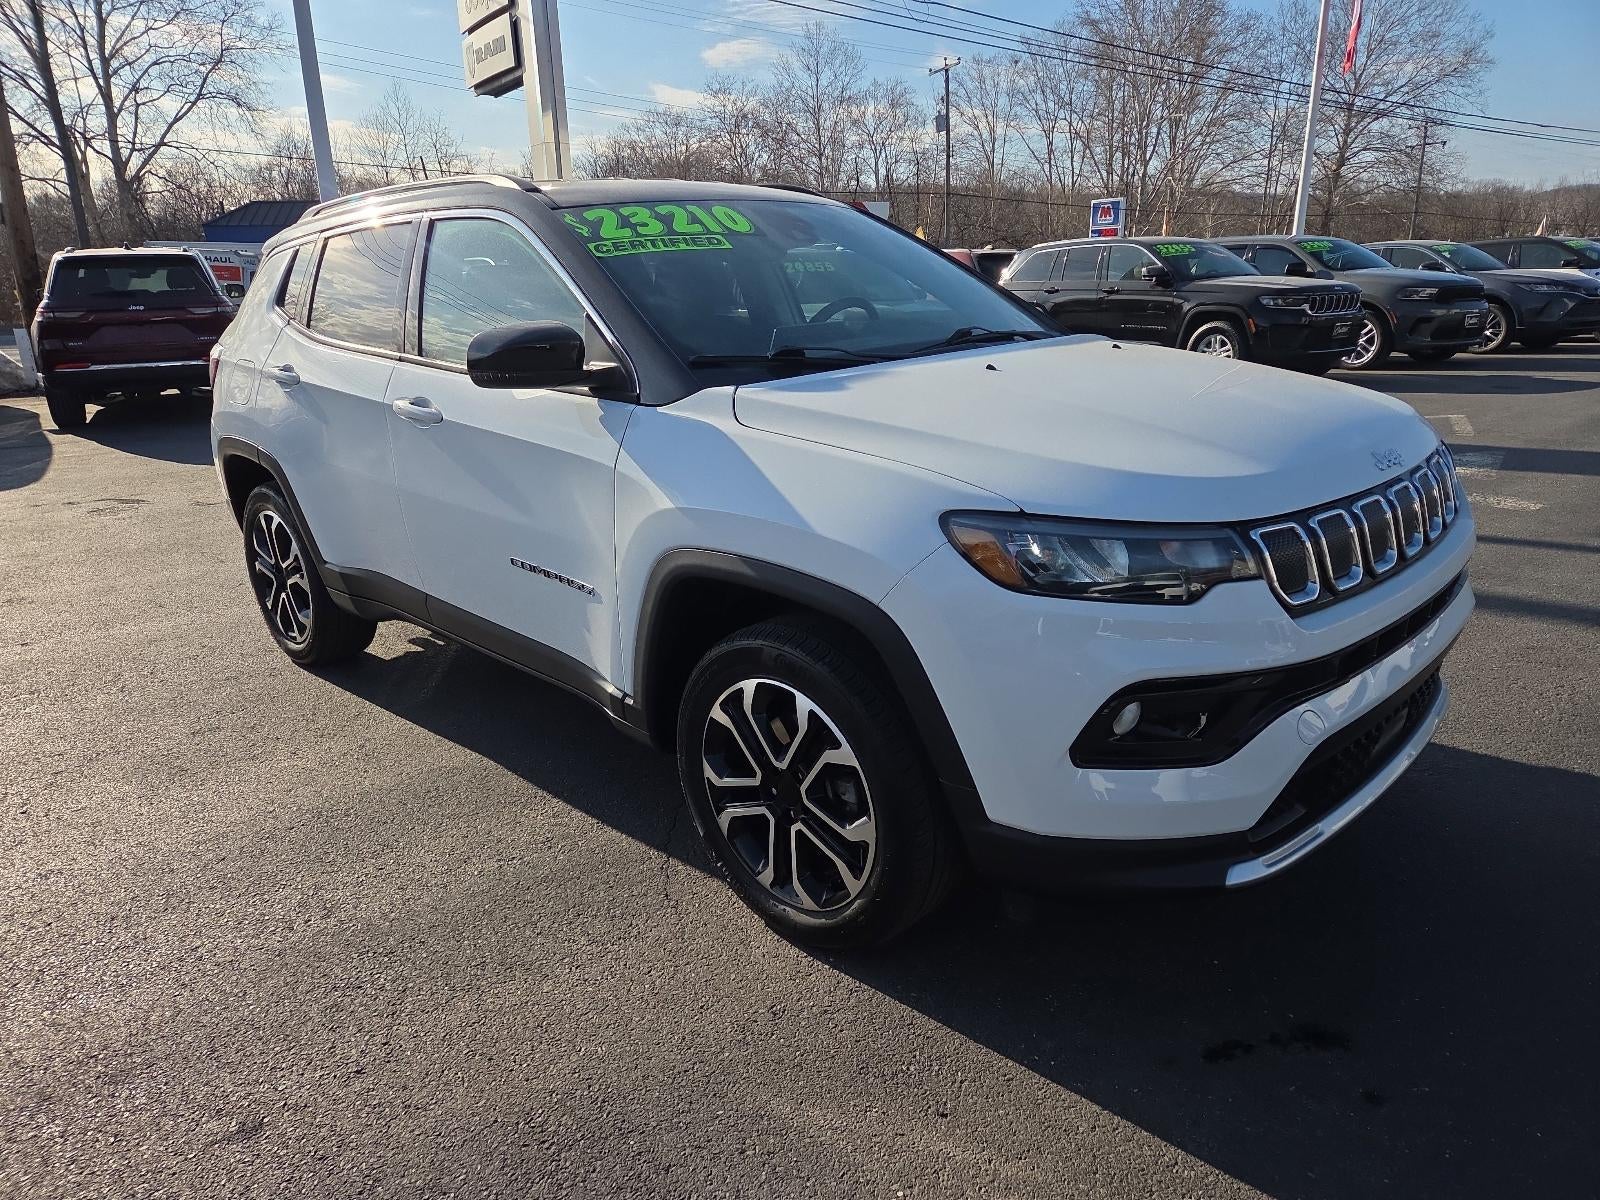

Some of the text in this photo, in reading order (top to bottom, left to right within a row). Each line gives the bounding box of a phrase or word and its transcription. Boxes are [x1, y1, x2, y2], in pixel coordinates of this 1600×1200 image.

[474, 35, 507, 66] RAM
[563, 205, 754, 239] $23210
[593, 235, 725, 255] CERTIFIED
